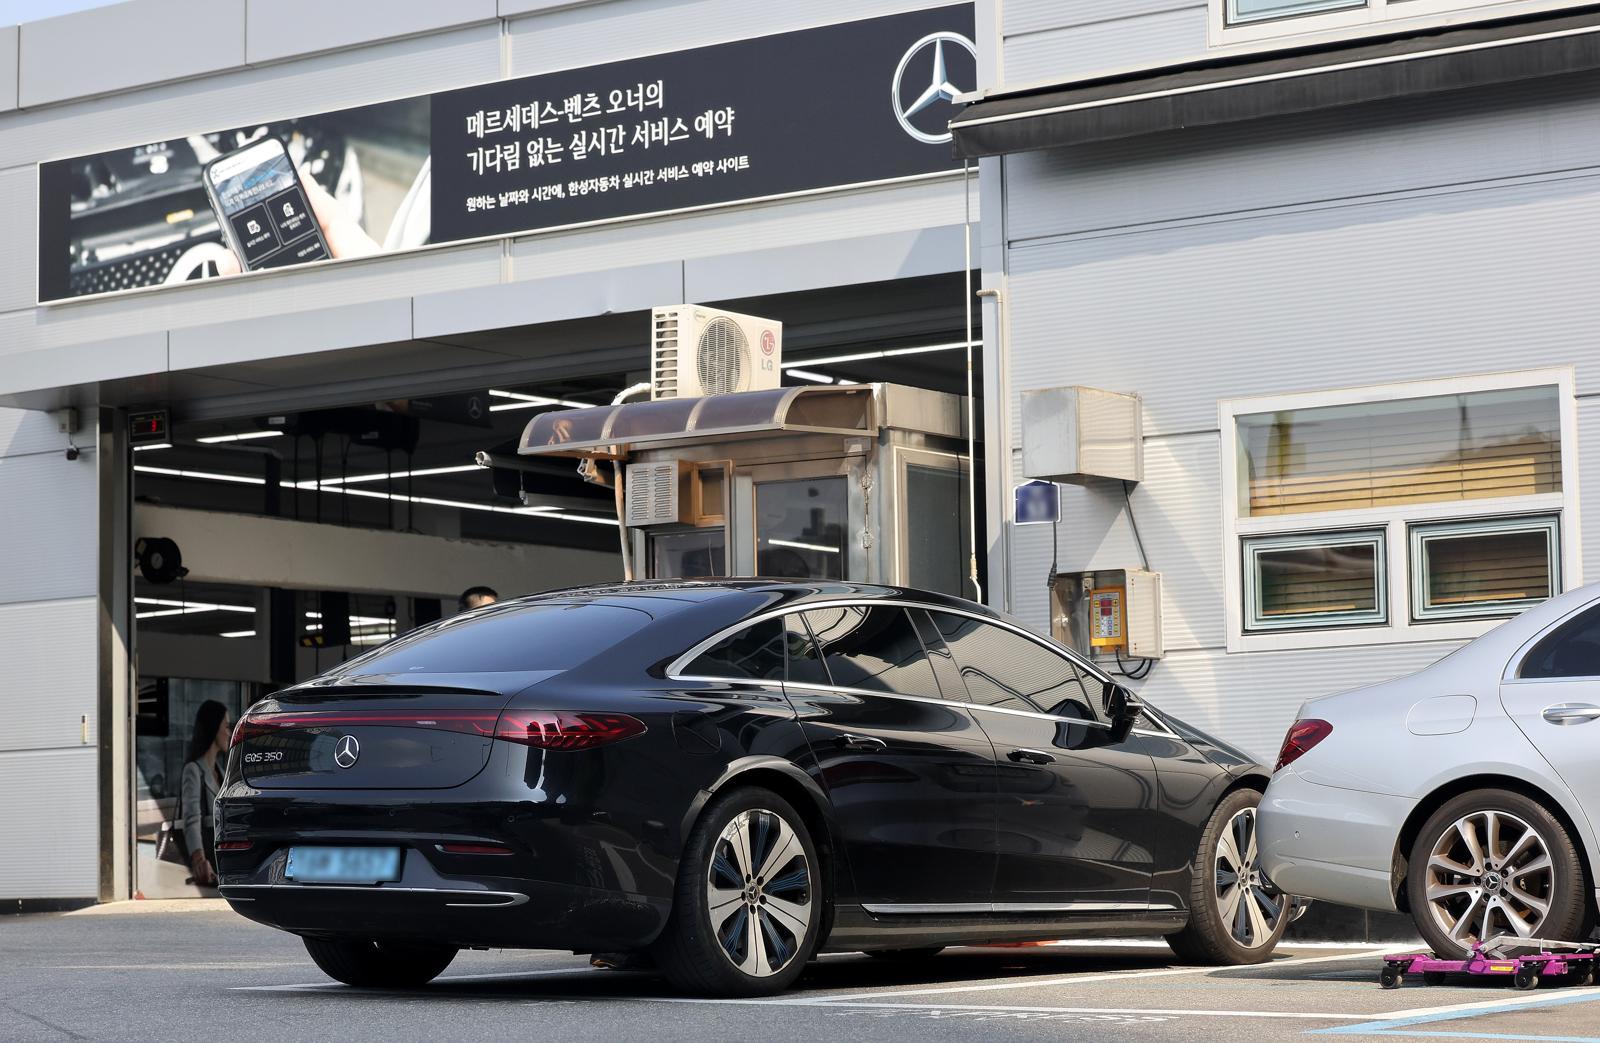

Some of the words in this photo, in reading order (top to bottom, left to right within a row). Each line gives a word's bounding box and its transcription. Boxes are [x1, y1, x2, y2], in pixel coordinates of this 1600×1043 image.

[466, 93, 601, 138] 메르세데스-벤츠
[606, 80, 663, 112] 오너의
[466, 142, 521, 175] 기다림
[526, 138, 564, 168] 없는
[568, 124, 626, 160] 실시간
[631, 117, 690, 149] 서비스
[694, 107, 735, 139] 예약
[466, 195, 496, 212] 원하는
[498, 189, 529, 207] 날짜와
[531, 183, 566, 201] 시간에,
[568, 175, 620, 197] 한성자동차
[622, 170, 654, 188] 실시간
[656, 165, 690, 182] 서비스
[691, 160, 714, 177] 예약
[716, 155, 750, 174] 사이트
[761, 359, 773, 371] LG
[244, 753, 263, 762] EQS
[264, 752, 283, 761] 350
